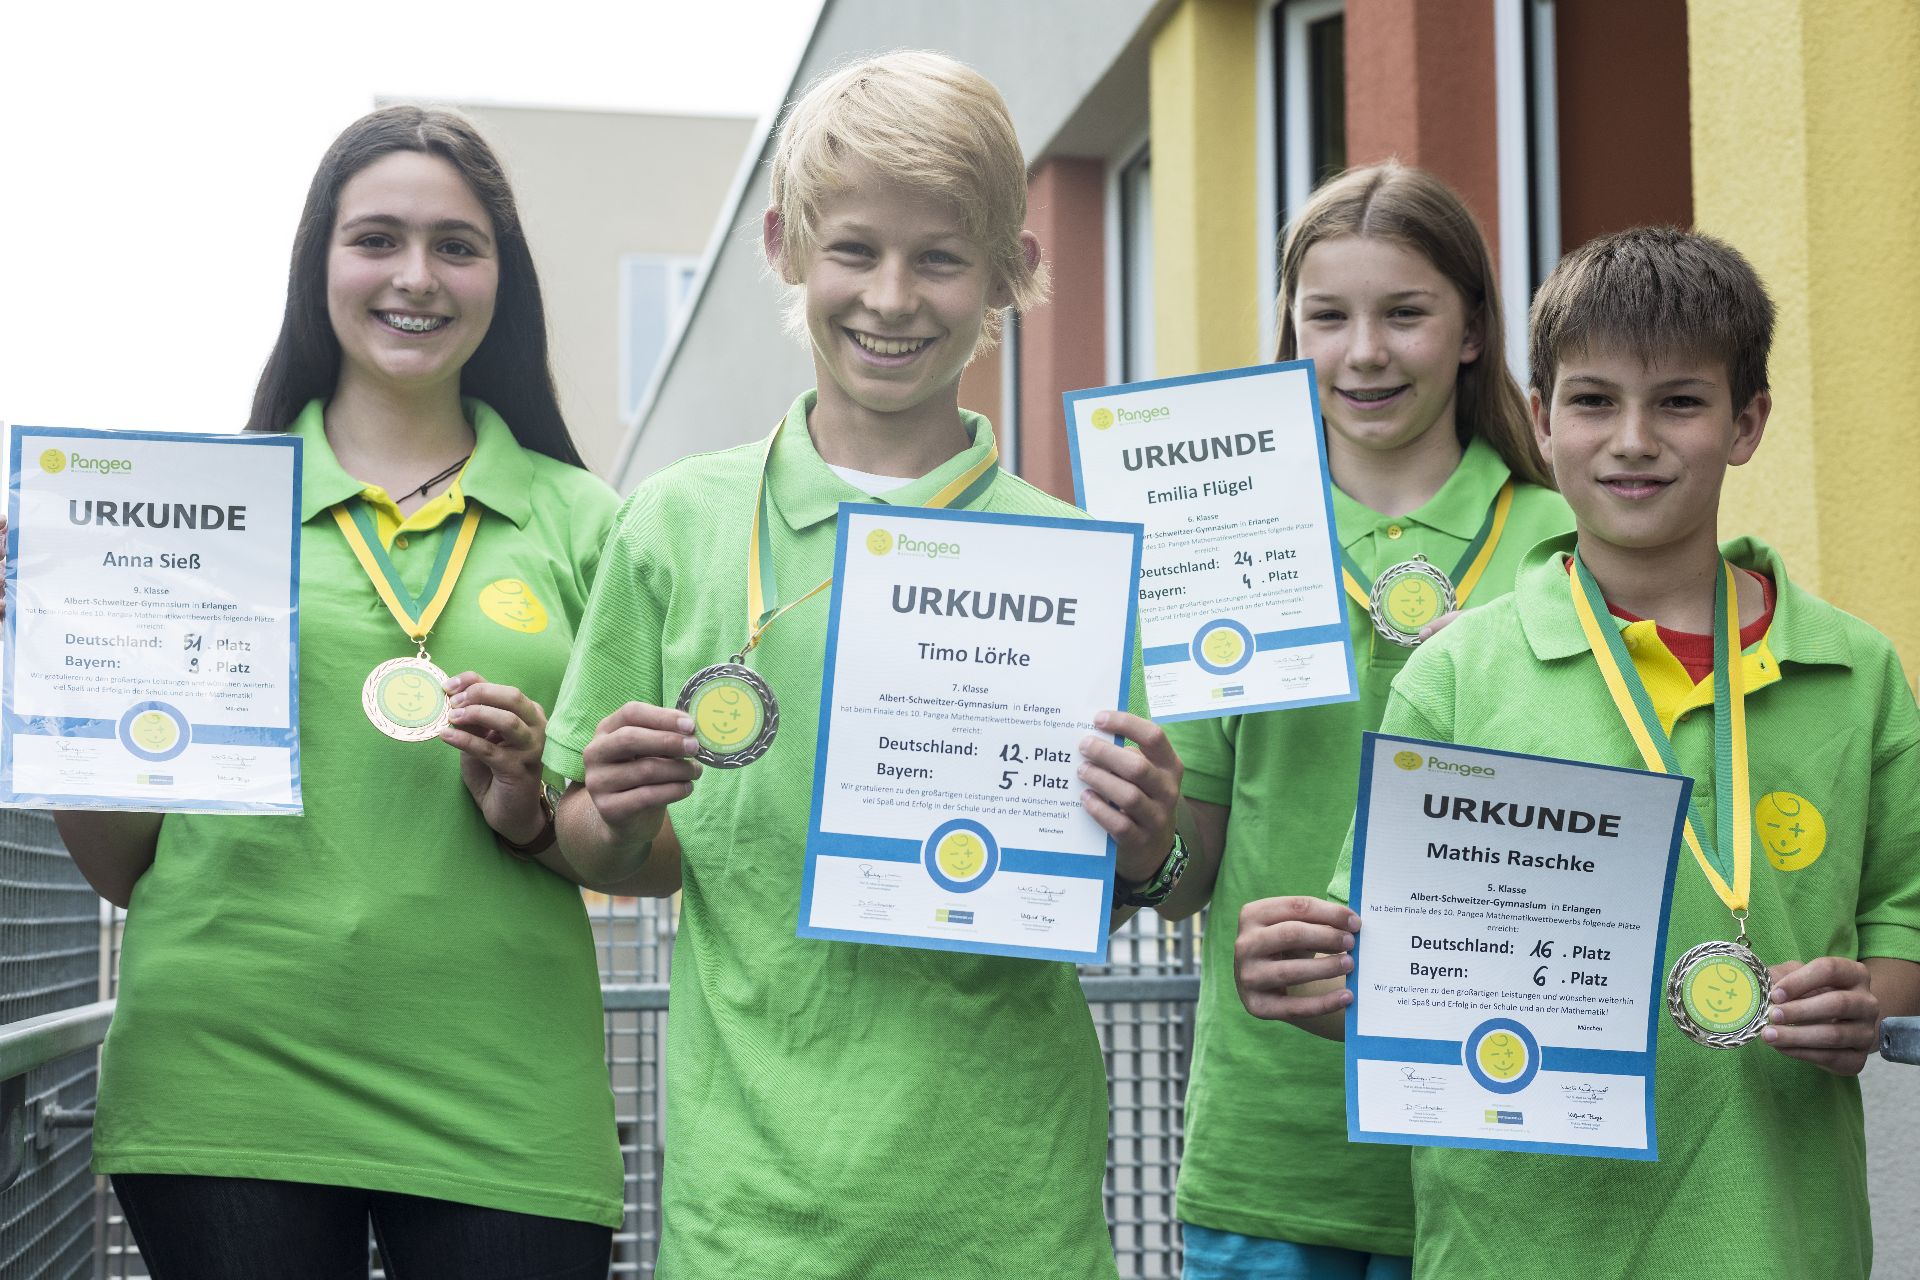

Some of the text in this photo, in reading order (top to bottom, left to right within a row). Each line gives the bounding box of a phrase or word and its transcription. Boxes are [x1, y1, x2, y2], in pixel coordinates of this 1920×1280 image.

[1116, 405, 1170, 426] Pangea
[1121, 429, 1276, 472] URKUNDE
[70, 452, 132, 475] Pangea
[1147, 475, 1253, 504] Emilia Flügel
[69, 499, 247, 532] URKUNDE
[1196, 514, 1219, 522] Klasse
[896, 533, 961, 559] Pangea
[102, 551, 201, 570] Anna Sieß
[1139, 557, 1220, 577] Deutschland:
[1265, 549, 1297, 562] Platz
[133, 585, 170, 595] 9. Klasse
[1139, 586, 1186, 601] Bayern:
[1268, 570, 1299, 582] Platz
[891, 584, 1078, 626] URKUNDE
[65, 633, 163, 649] Deutschland:
[216, 637, 251, 652] Platz
[917, 642, 1030, 667] Timo Lörke
[64, 655, 121, 670] Bayern:
[216, 661, 251, 674] Platz
[952, 683, 989, 694] 7. Klasse
[878, 693, 1061, 715] Albert-Schweitzer-Gymnasium in Erlangen
[878, 736, 978, 756] Deutschland:
[1034, 747, 1071, 763] Platz
[876, 762, 933, 780] Bayern:
[1032, 773, 1069, 790] Platz
[1427, 755, 1495, 779] Pangea
[1423, 793, 1622, 838] URKUNDE
[1426, 842, 1595, 873] Mathis Raschke
[1487, 883, 1527, 895] 5. Klasse
[1410, 892, 1547, 910] Albert-Schweitzer-Gymnasium
[1561, 903, 1601, 916] Erlangen
[1370, 904, 1382, 912] hat
[1383, 904, 1403, 913] beim
[1404, 906, 1427, 915] Finale
[1428, 907, 1442, 916] des
[1456, 909, 1484, 919] Pangea
[1485, 911, 1581, 926] Mathematikwettbewerbs
[1582, 918, 1616, 929] folgende
[1617, 921, 1641, 931] Plätze
[1411, 935, 1514, 955] Deutschland:
[1572, 945, 1611, 961] Platz
[1410, 962, 1468, 980] Bayern:
[1570, 971, 1608, 987] Platz
[1373, 983, 1387, 991] Wir
[1388, 985, 1429, 994] gratulieren
[1440, 987, 1455, 995] den
[1456, 988, 1499, 999] großartigen
[1501, 990, 1541, 1001] Leistungen
[1542, 993, 1558, 1001] und
[1558, 994, 1597, 1003] wünschen
[1598, 996, 1634, 1005] weiterhin
[1397, 997, 1410, 1006] viel
[1411, 998, 1430, 1007] Spaß
[1431, 999, 1446, 1007] und
[1447, 1000, 1469, 1010] Erfolg
[1470, 1001, 1478, 1009] in
[1493, 1002, 1518, 1011] Schule
[1519, 1004, 1534, 1012] und
[1546, 1005, 1559, 1014] der
[1560, 1006, 1609, 1016] Mathematik!
